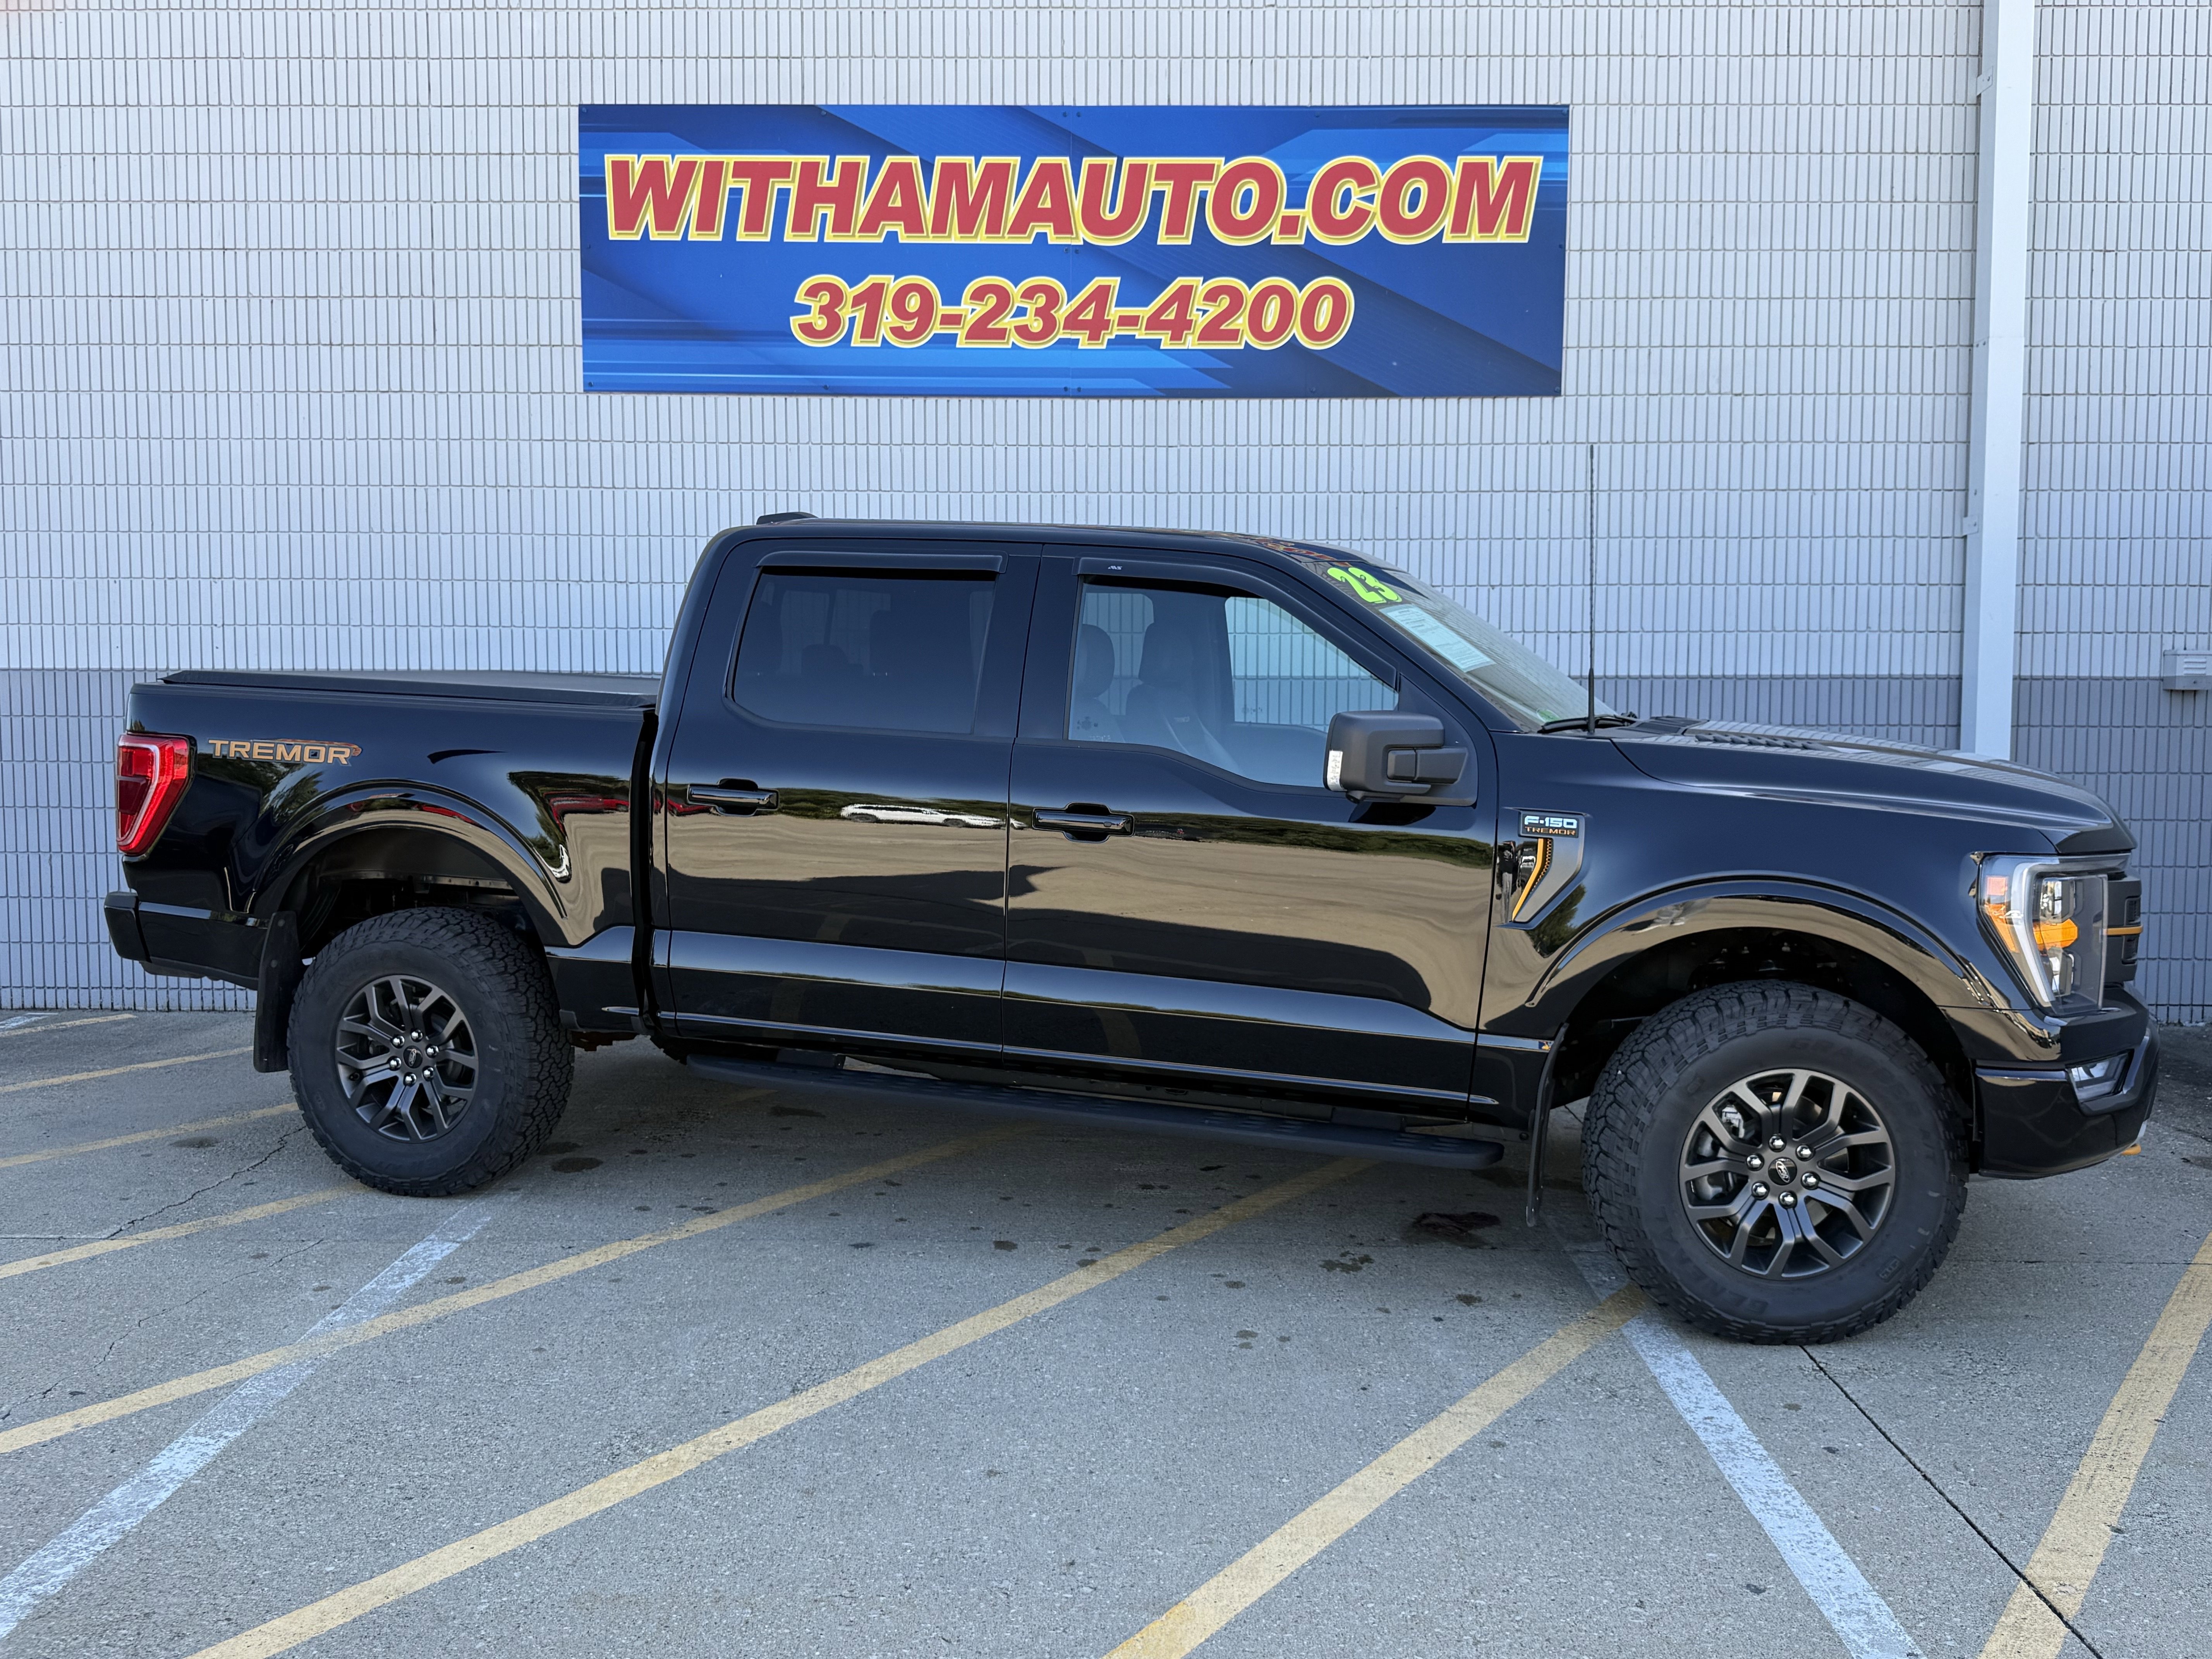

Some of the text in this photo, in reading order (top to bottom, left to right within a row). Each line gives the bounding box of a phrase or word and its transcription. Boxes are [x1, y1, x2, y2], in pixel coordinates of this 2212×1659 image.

[605, 155, 1543, 245] WITHAMAUTO.COM
[792, 275, 1355, 350] 319-234-4200
[1327, 567, 1402, 603] 23
[208, 739, 351, 766] TREMOR
[1525, 816, 1577, 828] F-150
[1525, 827, 1575, 835] TREMOR
